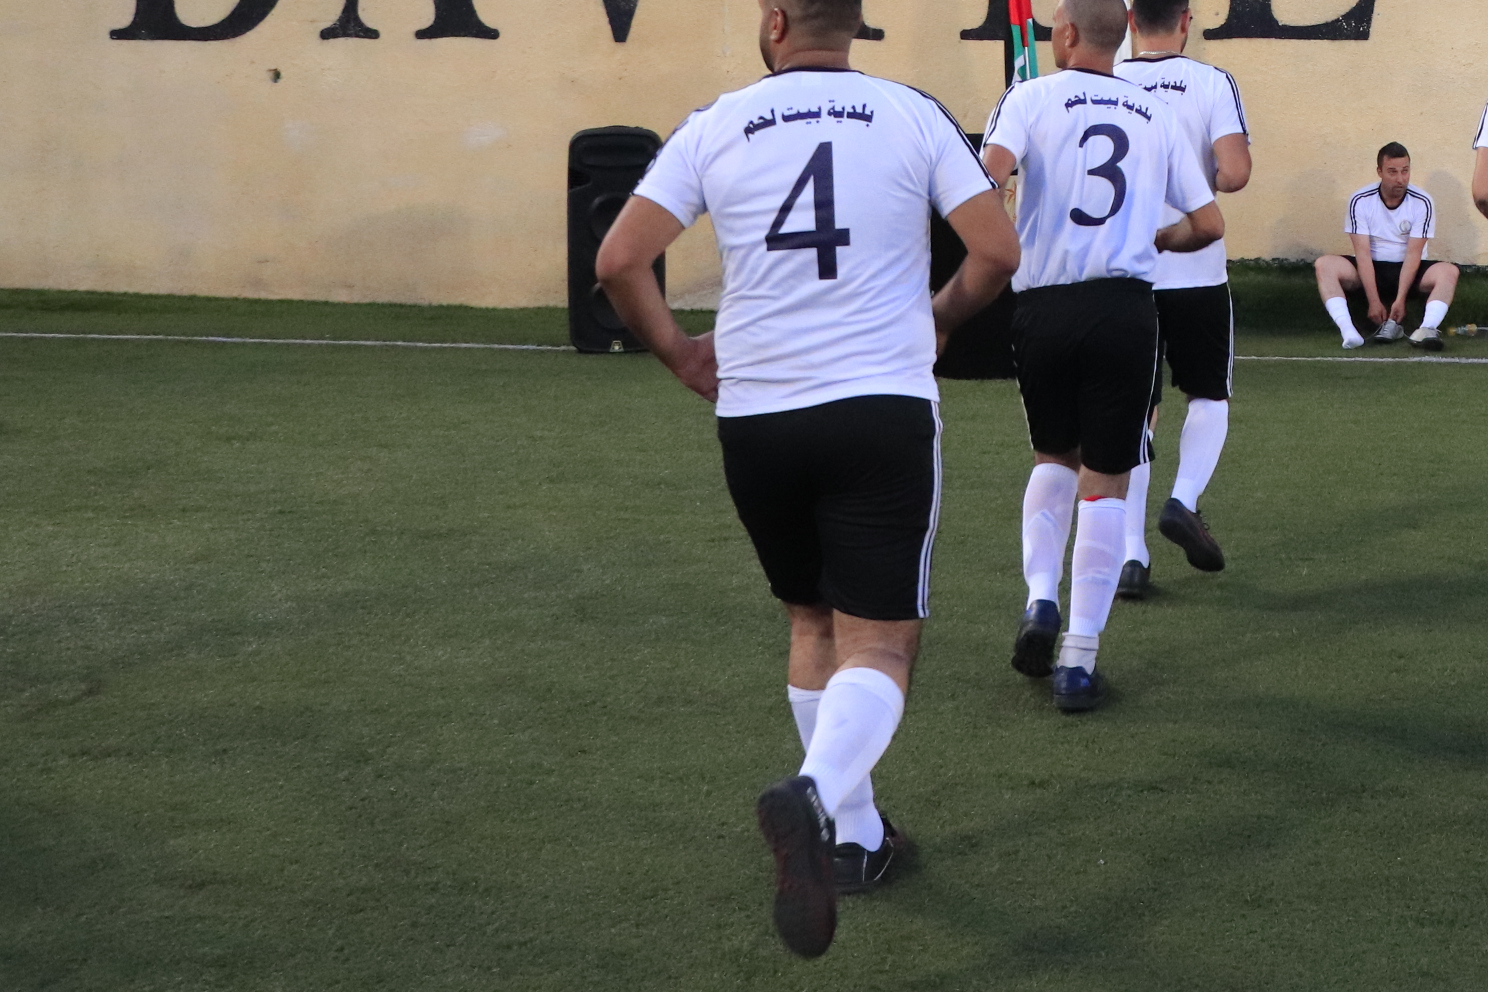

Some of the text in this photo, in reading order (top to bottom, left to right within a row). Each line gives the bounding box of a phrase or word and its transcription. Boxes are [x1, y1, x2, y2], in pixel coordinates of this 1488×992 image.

[743, 99, 874, 143] بلدية بيت لحم
[1064, 91, 1152, 124] بلدية بيت لحم
[765, 140, 850, 280] 4
[1069, 123, 1130, 227] 3
